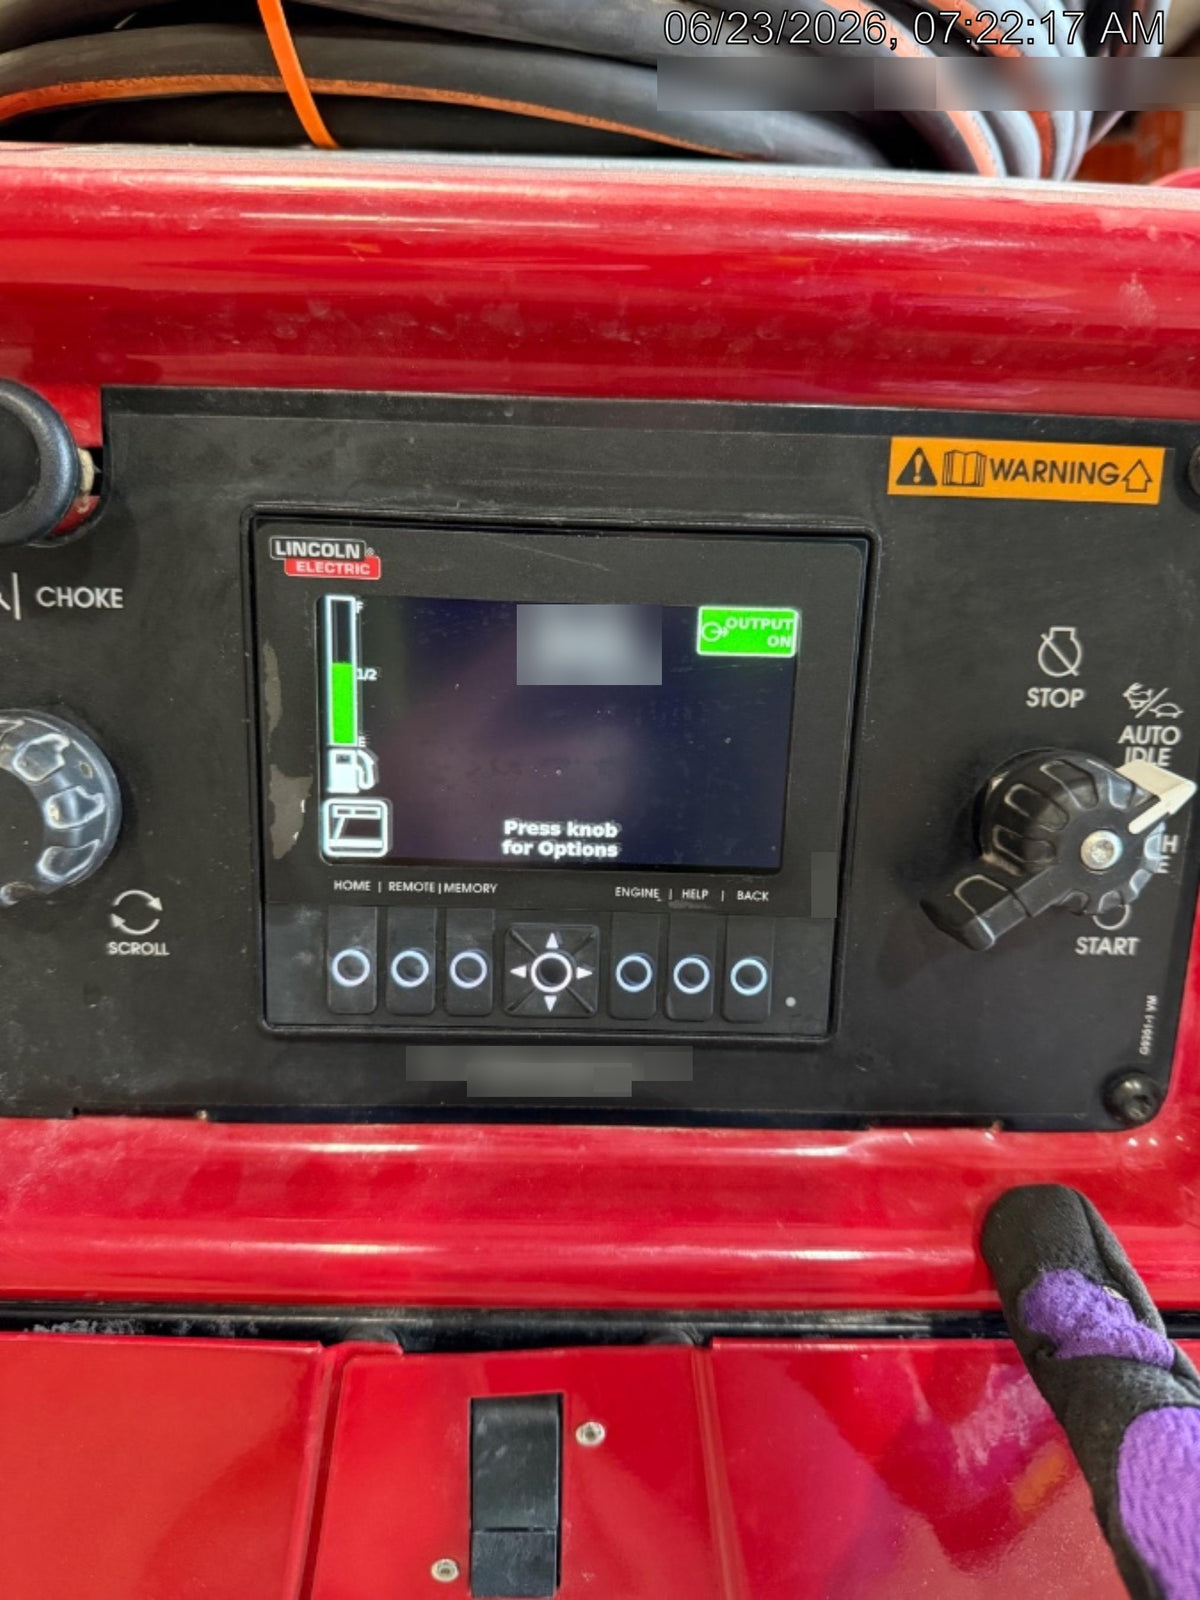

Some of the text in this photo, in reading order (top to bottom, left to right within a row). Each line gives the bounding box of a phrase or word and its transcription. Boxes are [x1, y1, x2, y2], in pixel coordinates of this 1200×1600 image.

[990, 457, 1121, 486] WARNING
[274, 540, 362, 560] LINCOLN
[296, 560, 371, 577] ELECTRIC
[35, 585, 124, 610] CHOKE
[725, 616, 795, 632] OUTPUT
[767, 635, 793, 649] ON
[356, 667, 378, 682] 1/2
[1026, 687, 1084, 709] STOP
[1118, 724, 1182, 747] AUTO
[503, 819, 619, 839] Press knob
[501, 839, 619, 860] for Options
[333, 879, 499, 895] HOME REMOTE MEMORY
[614, 886, 770, 902] ENGINE HELP BACK
[107, 941, 170, 956] SCROLL
[1075, 936, 1139, 956] START
